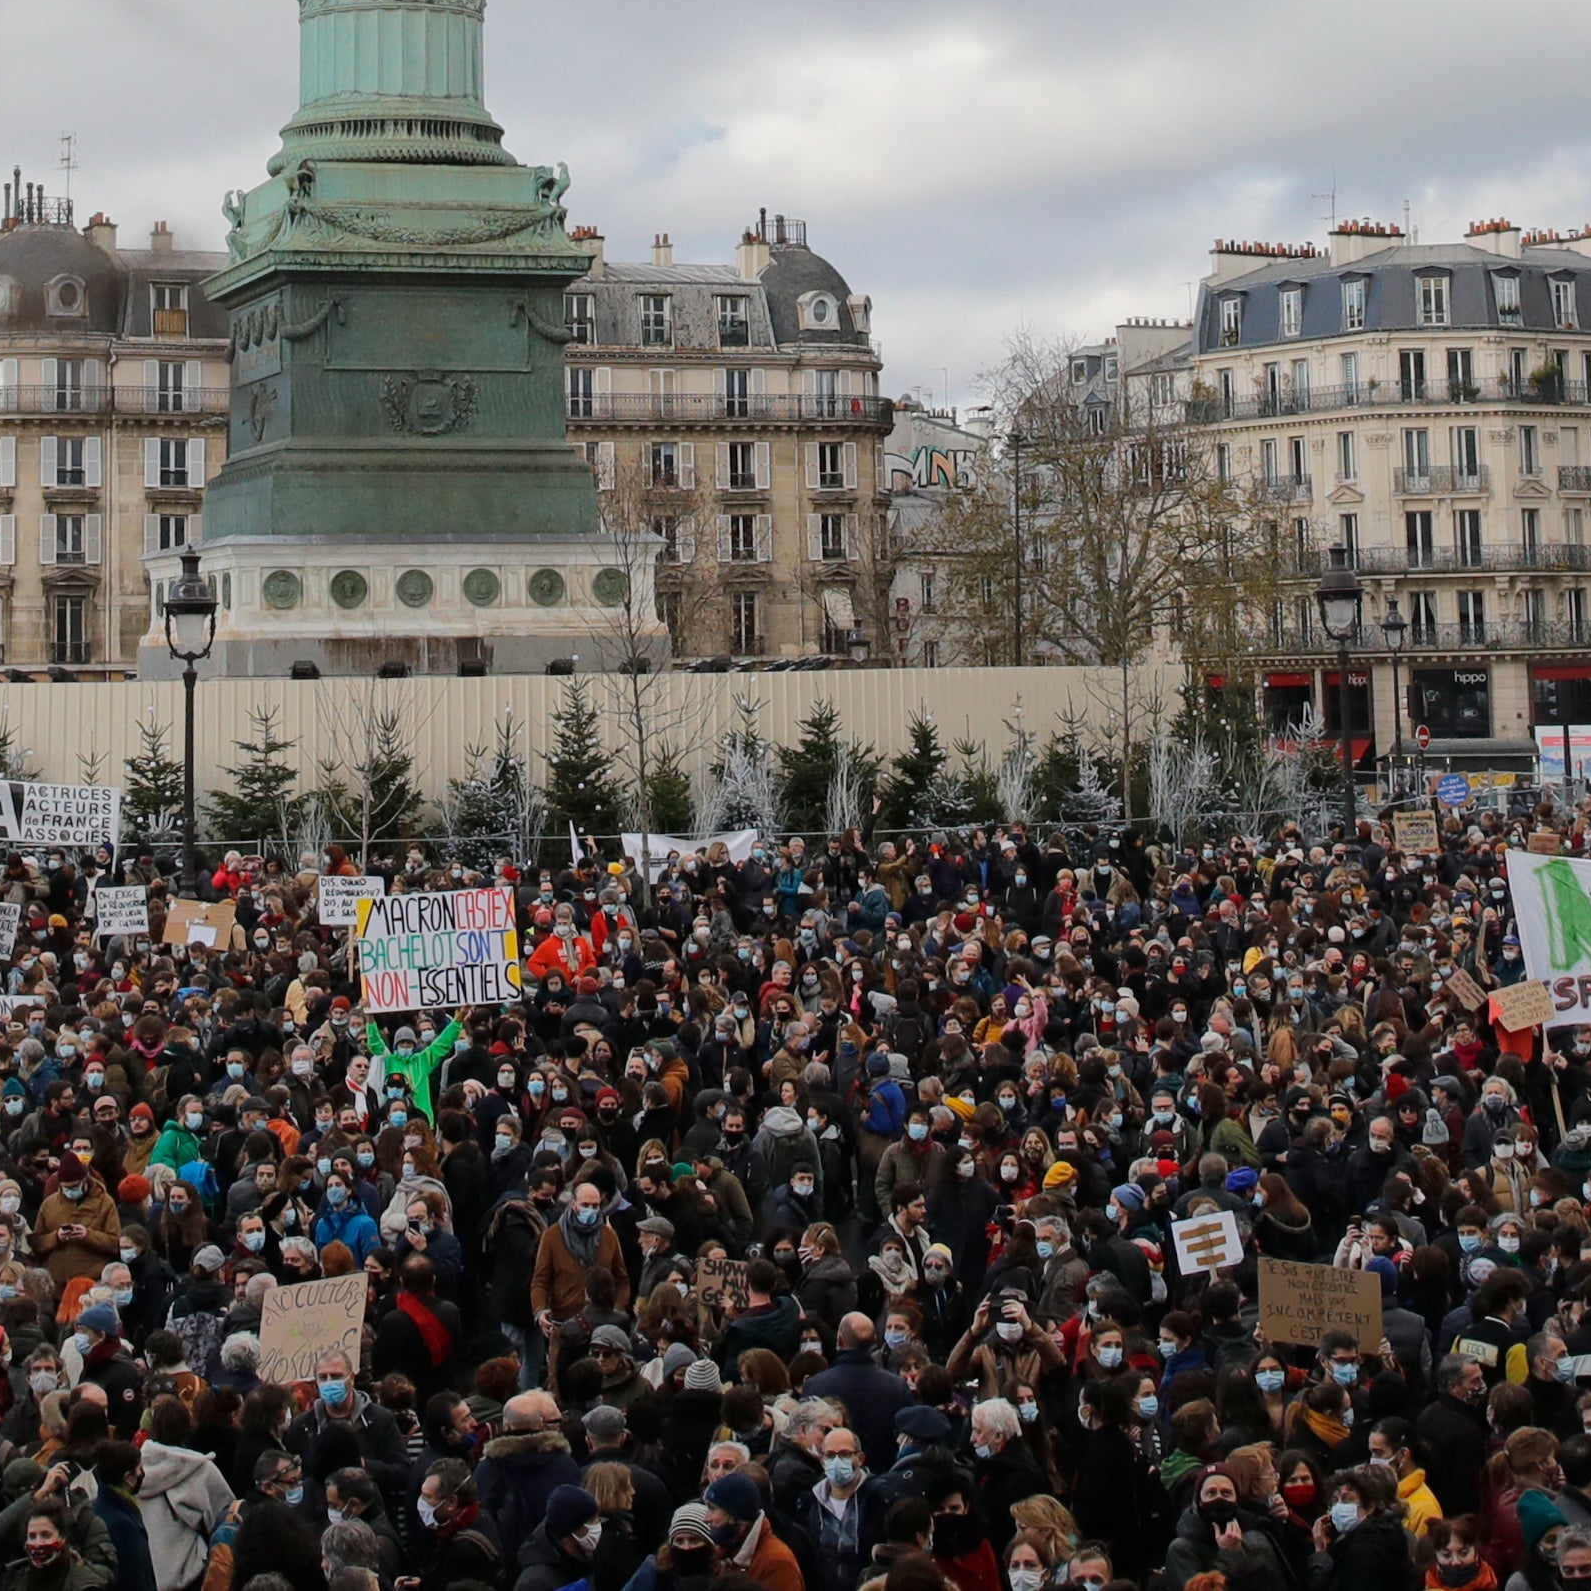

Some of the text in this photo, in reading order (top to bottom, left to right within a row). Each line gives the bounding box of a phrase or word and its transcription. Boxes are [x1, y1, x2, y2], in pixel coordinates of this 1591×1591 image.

[1454, 670, 1487, 685] hippo
[27, 785, 112, 801] ACTRICES
[26, 799, 112, 815] ACTEURS
[25, 814, 111, 829] de FRANCE
[24, 827, 111, 843] ASSOCIÉS
[363, 888, 517, 938] MACRON CASTEX
[359, 931, 457, 974] BACHELOT
[456, 929, 511, 966] SONT
[365, 962, 525, 1008] NON-ESSENTIELS
[295, 1279, 365, 1319] CULTURE
[1299, 1291, 1324, 1306] MAIS
